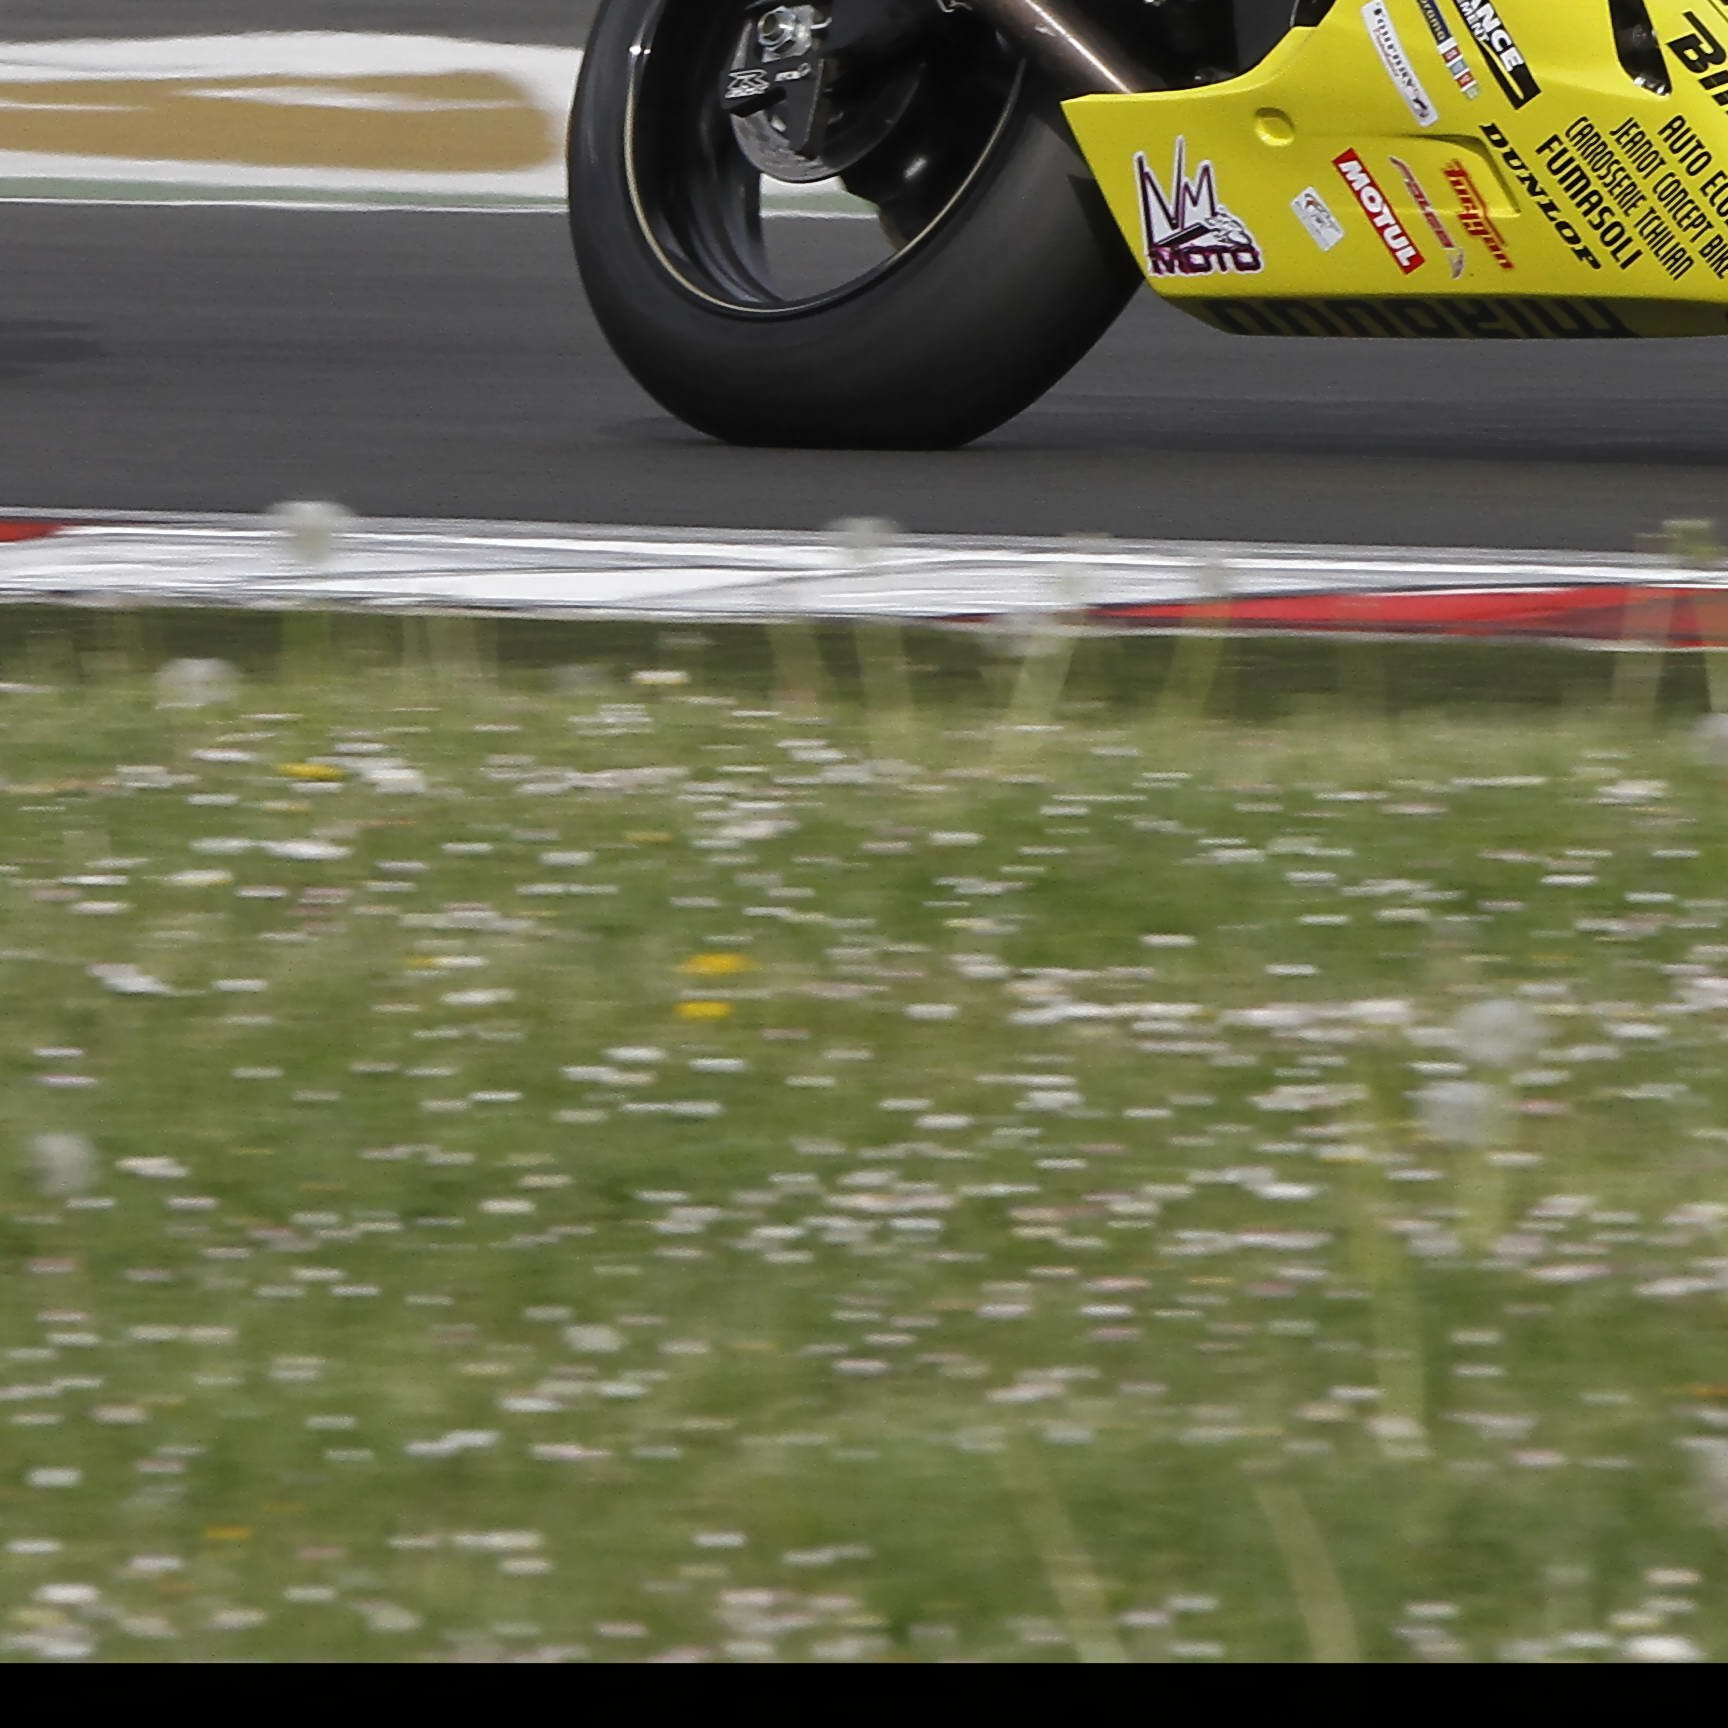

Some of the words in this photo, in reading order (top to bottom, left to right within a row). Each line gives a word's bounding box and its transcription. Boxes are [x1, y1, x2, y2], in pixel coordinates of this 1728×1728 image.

[1478, 122, 1601, 270] DUNLOP
[1564, 116, 1647, 217] CARROSSERIE
[1657, 115, 1713, 177] AUTO
[1338, 160, 1418, 267] MOTUL
[1535, 134, 1643, 270] FUMASOLI
[1652, 171, 1714, 243] CONCEPT
